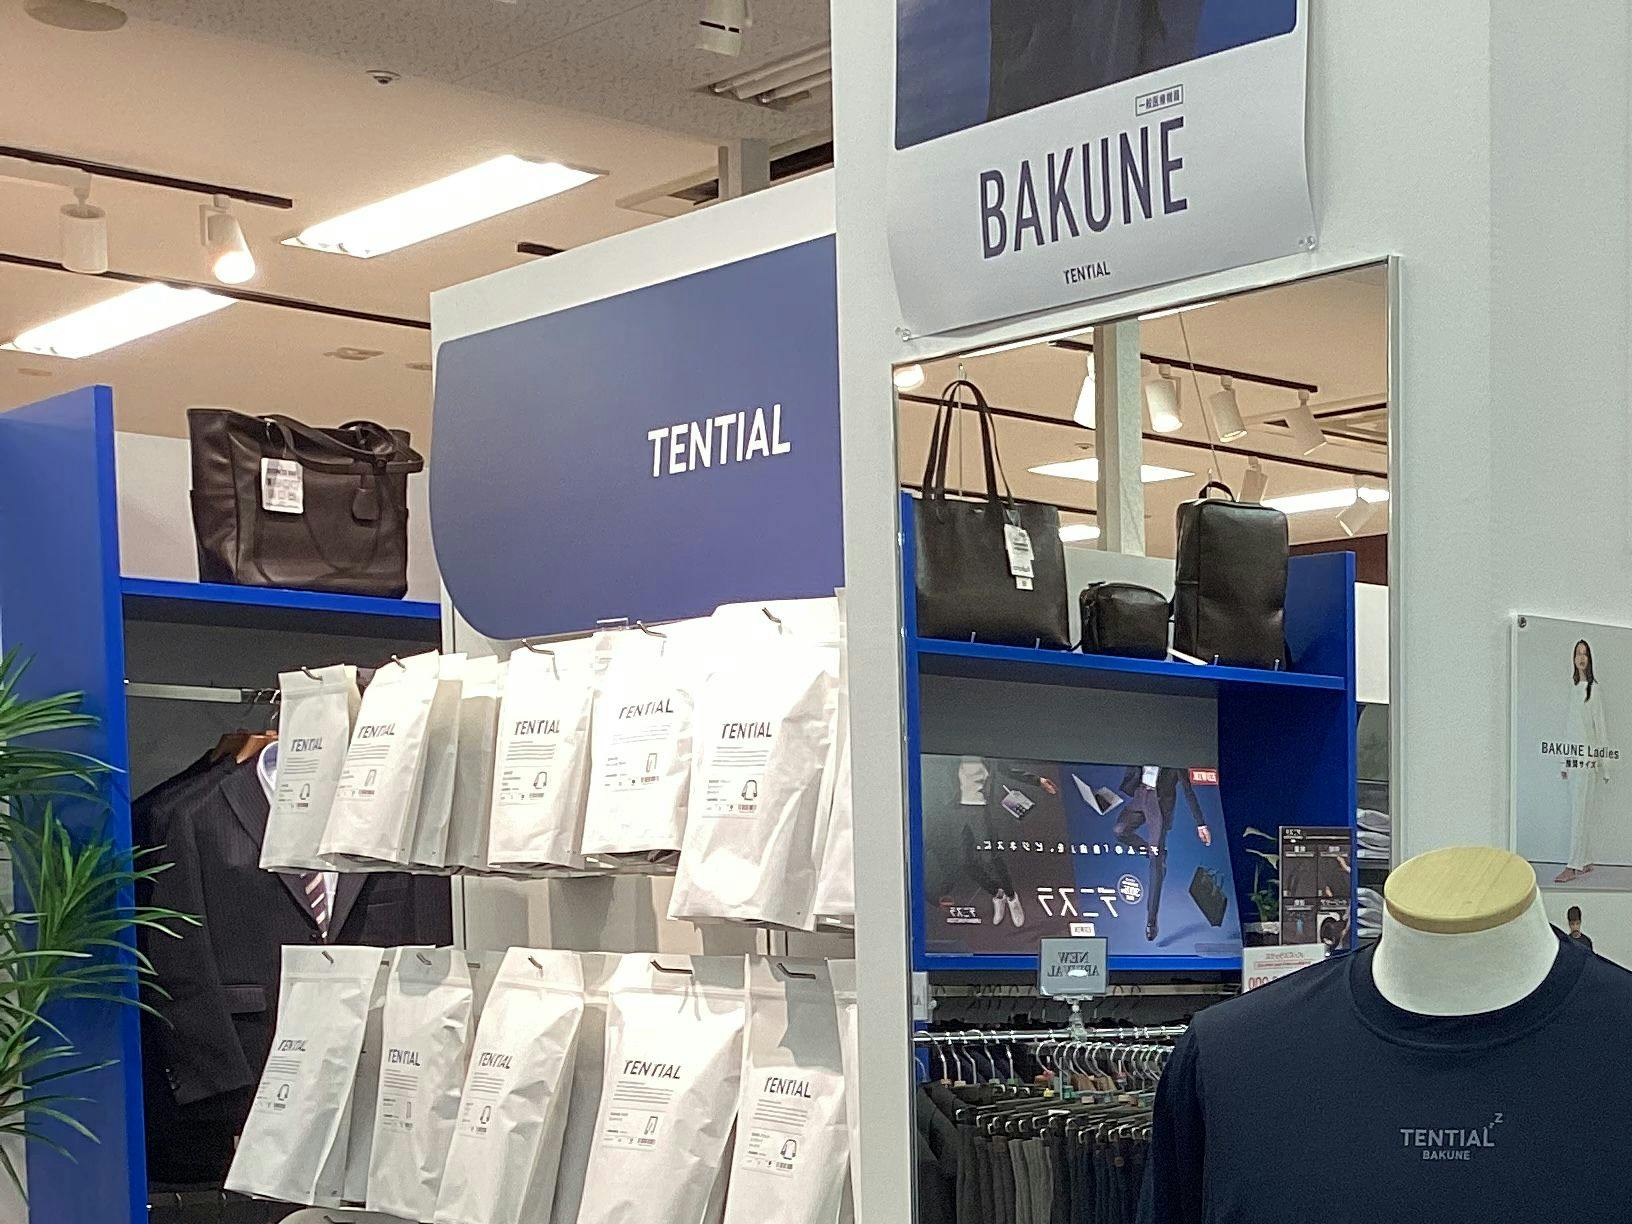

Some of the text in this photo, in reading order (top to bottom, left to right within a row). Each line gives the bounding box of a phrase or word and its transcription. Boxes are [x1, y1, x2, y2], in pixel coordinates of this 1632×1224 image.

[979, 115, 1188, 260] BAKUNE
[1063, 261, 1111, 285] TENTIAL
[647, 404, 792, 478] TENTIAL
[618, 698, 674, 720] TENTIAL
[357, 722, 396, 739] TENTIAL
[514, 718, 561, 736] TENTIAL
[721, 721, 773, 740] TENTIAL
[290, 736, 323, 752] TENTIAL
[1541, 741, 1620, 760] BAKUNE Ladies
[278, 1038, 307, 1053] TENTIAL
[387, 1047, 421, 1067] TENTIAL
[478, 1051, 511, 1070] TENTIAL
[623, 1059, 682, 1080] TENTIAL
[763, 1076, 812, 1098] TENTIAL
[1400, 1127, 1495, 1148] TENTIAL
[1422, 1150, 1471, 1161] BAKUNE
